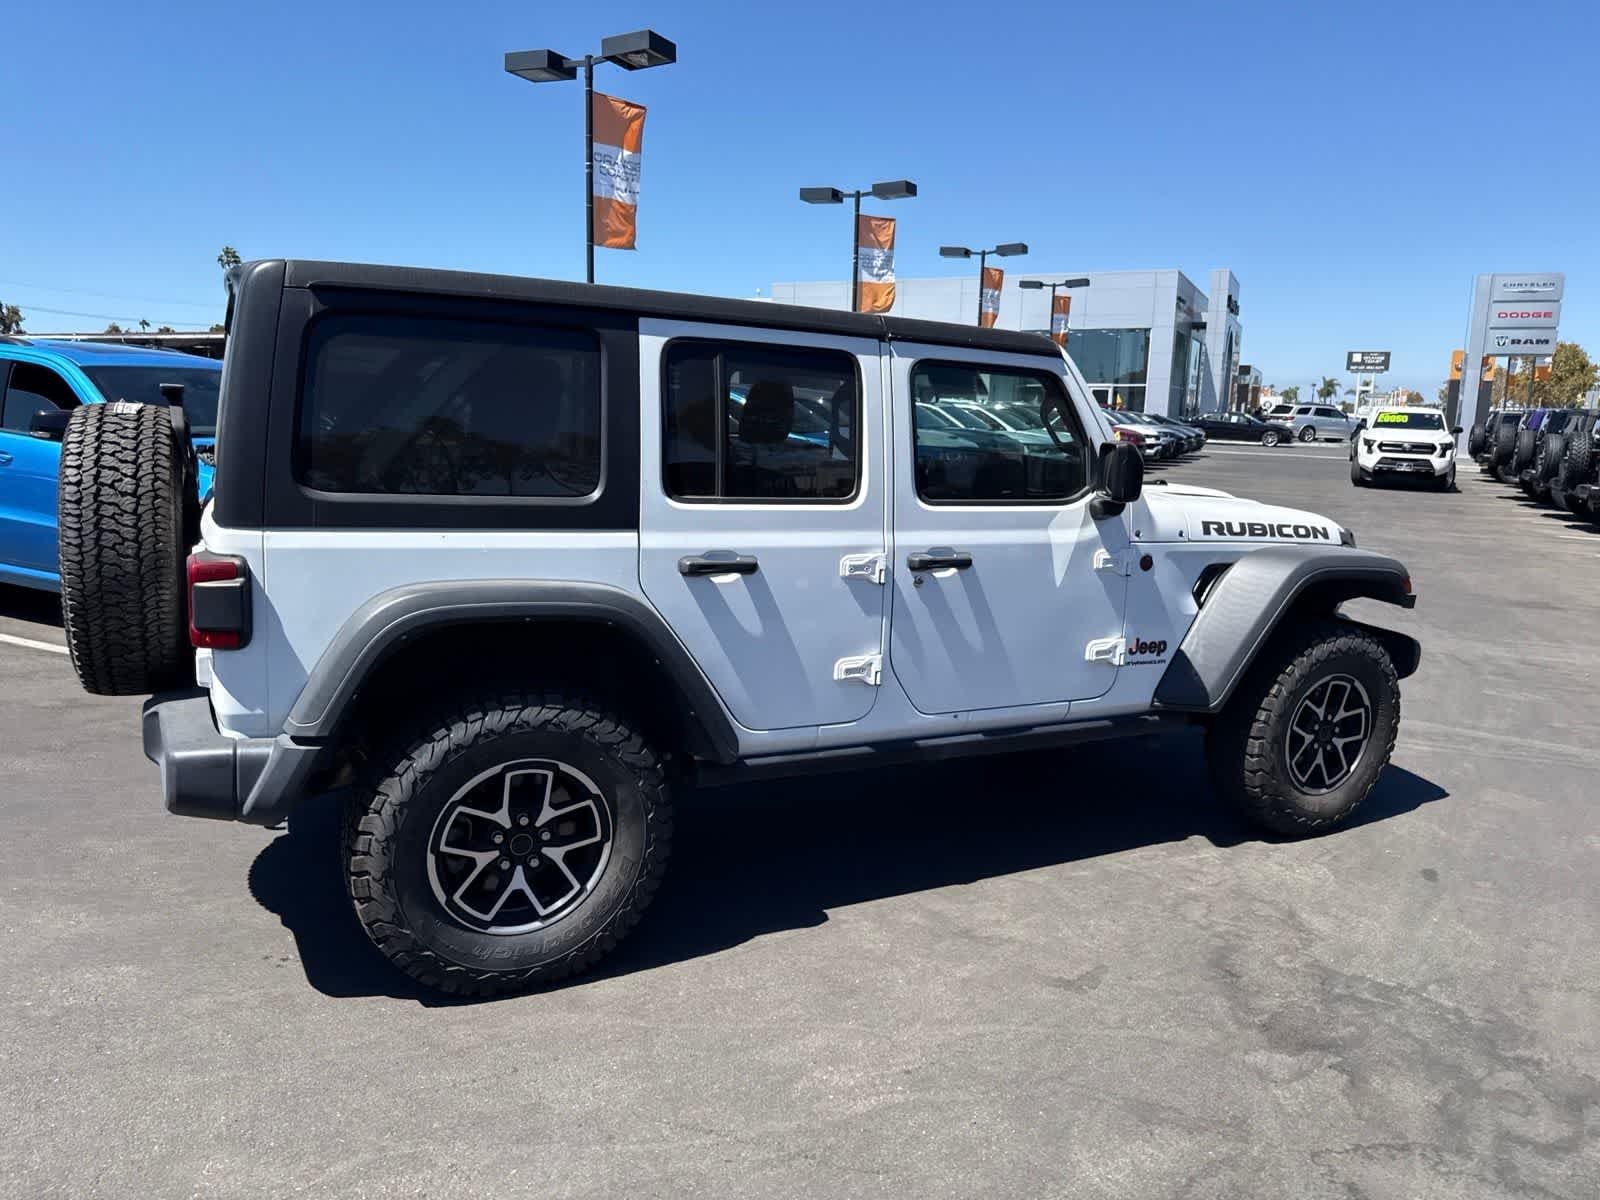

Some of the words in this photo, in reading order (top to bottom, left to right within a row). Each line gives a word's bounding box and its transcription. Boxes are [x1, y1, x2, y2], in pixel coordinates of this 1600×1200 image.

[1498, 311, 1553, 319] DODGE
[1201, 520, 1330, 540] RUBICON
[1128, 637, 1167, 656] Jeep
